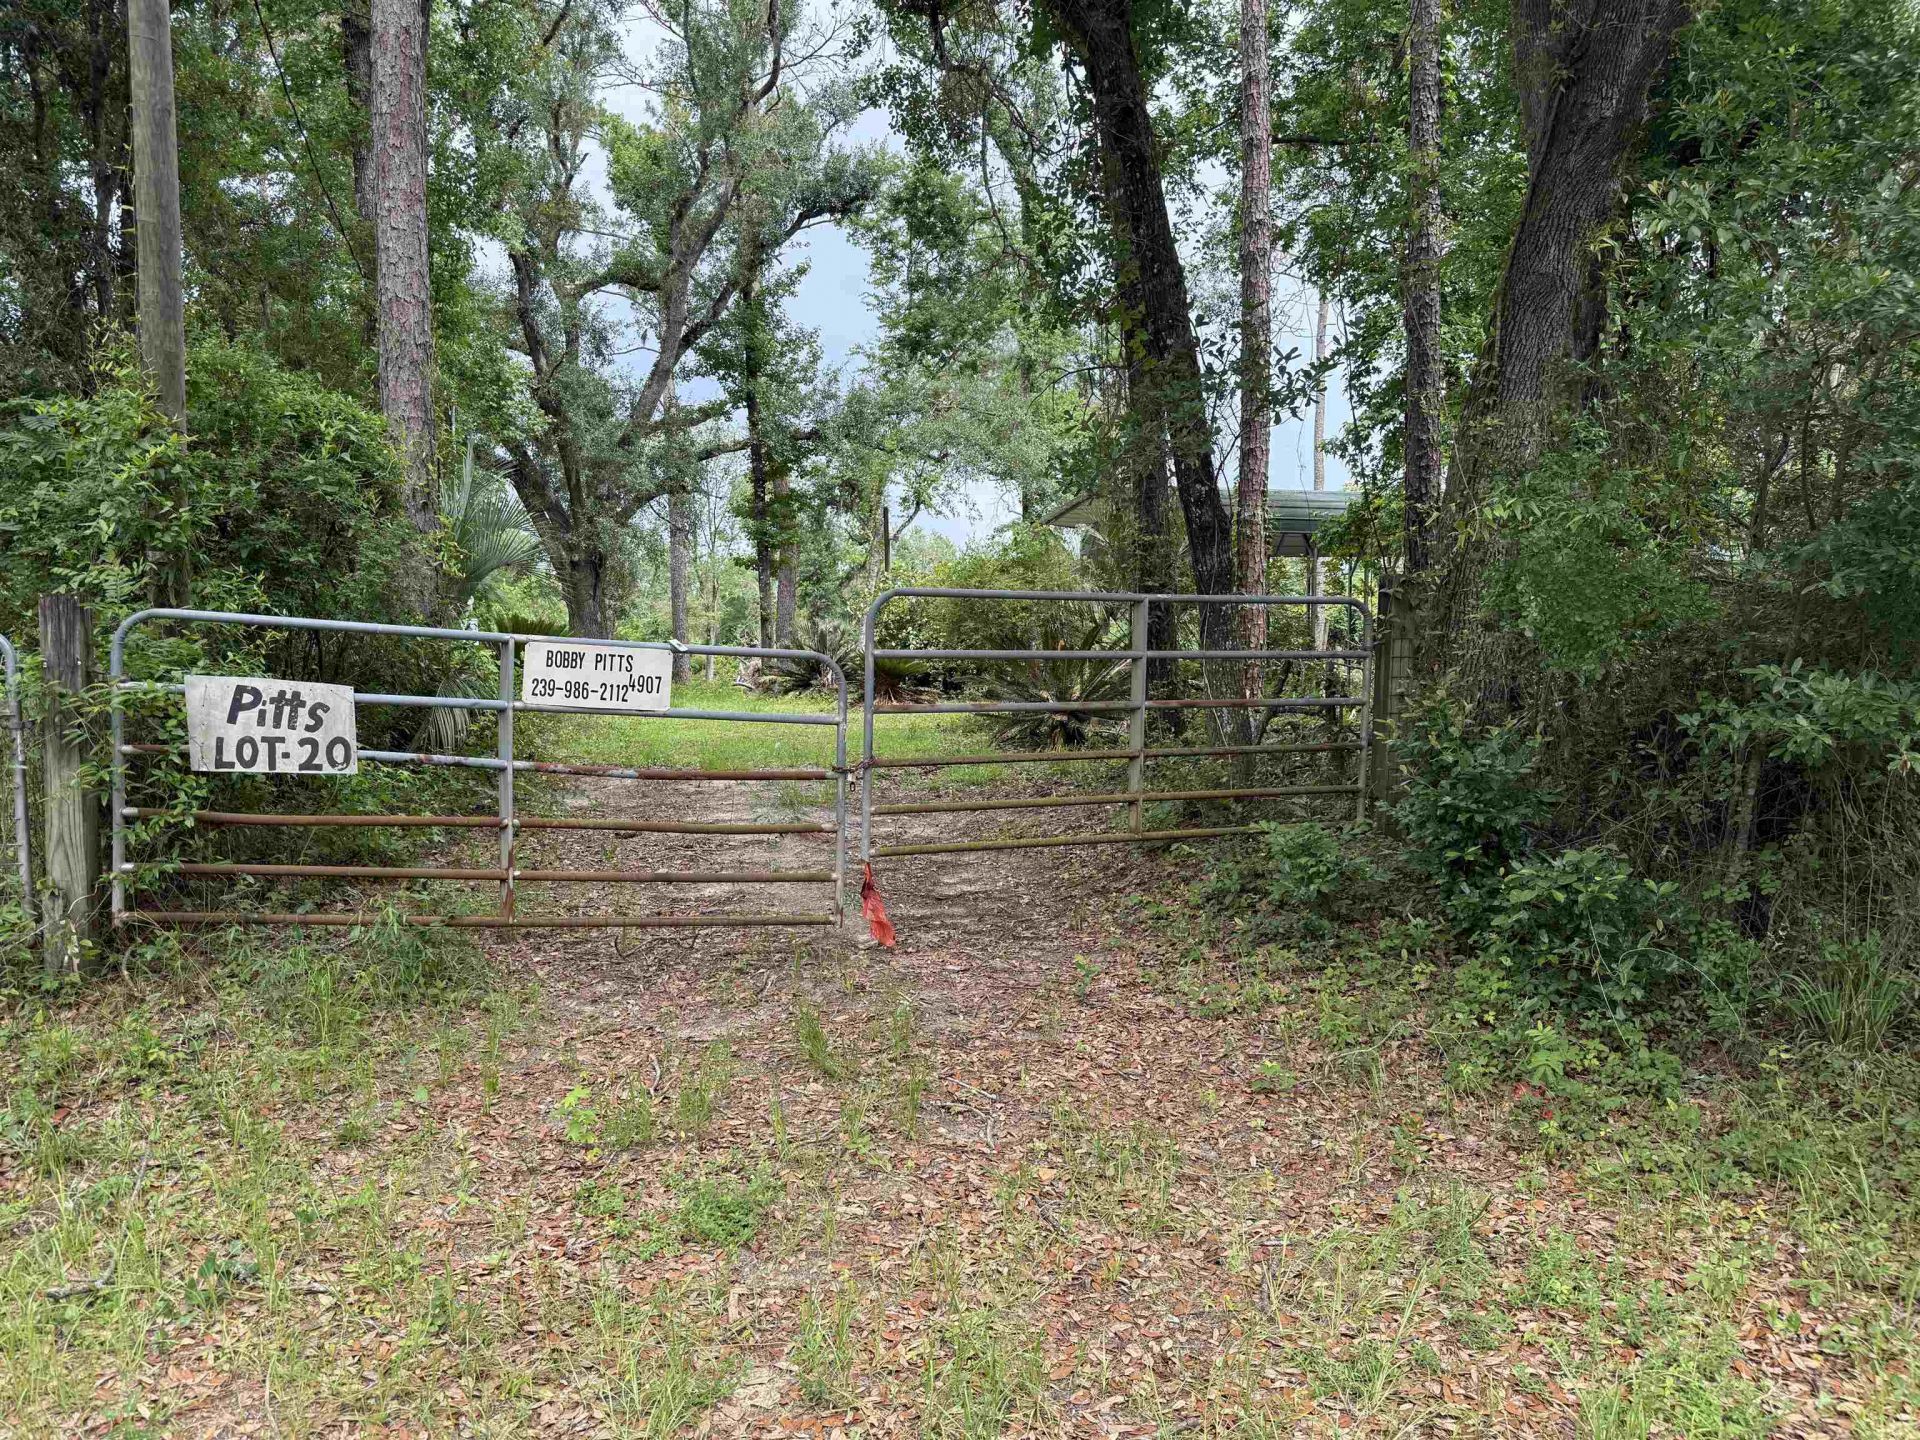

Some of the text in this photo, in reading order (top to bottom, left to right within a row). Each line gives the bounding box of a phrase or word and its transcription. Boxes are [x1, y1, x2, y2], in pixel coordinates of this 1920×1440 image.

[546, 650, 634, 673] BOBBY PITTS
[226, 684, 331, 733] Pitts
[214, 735, 352, 772] LOT-20
